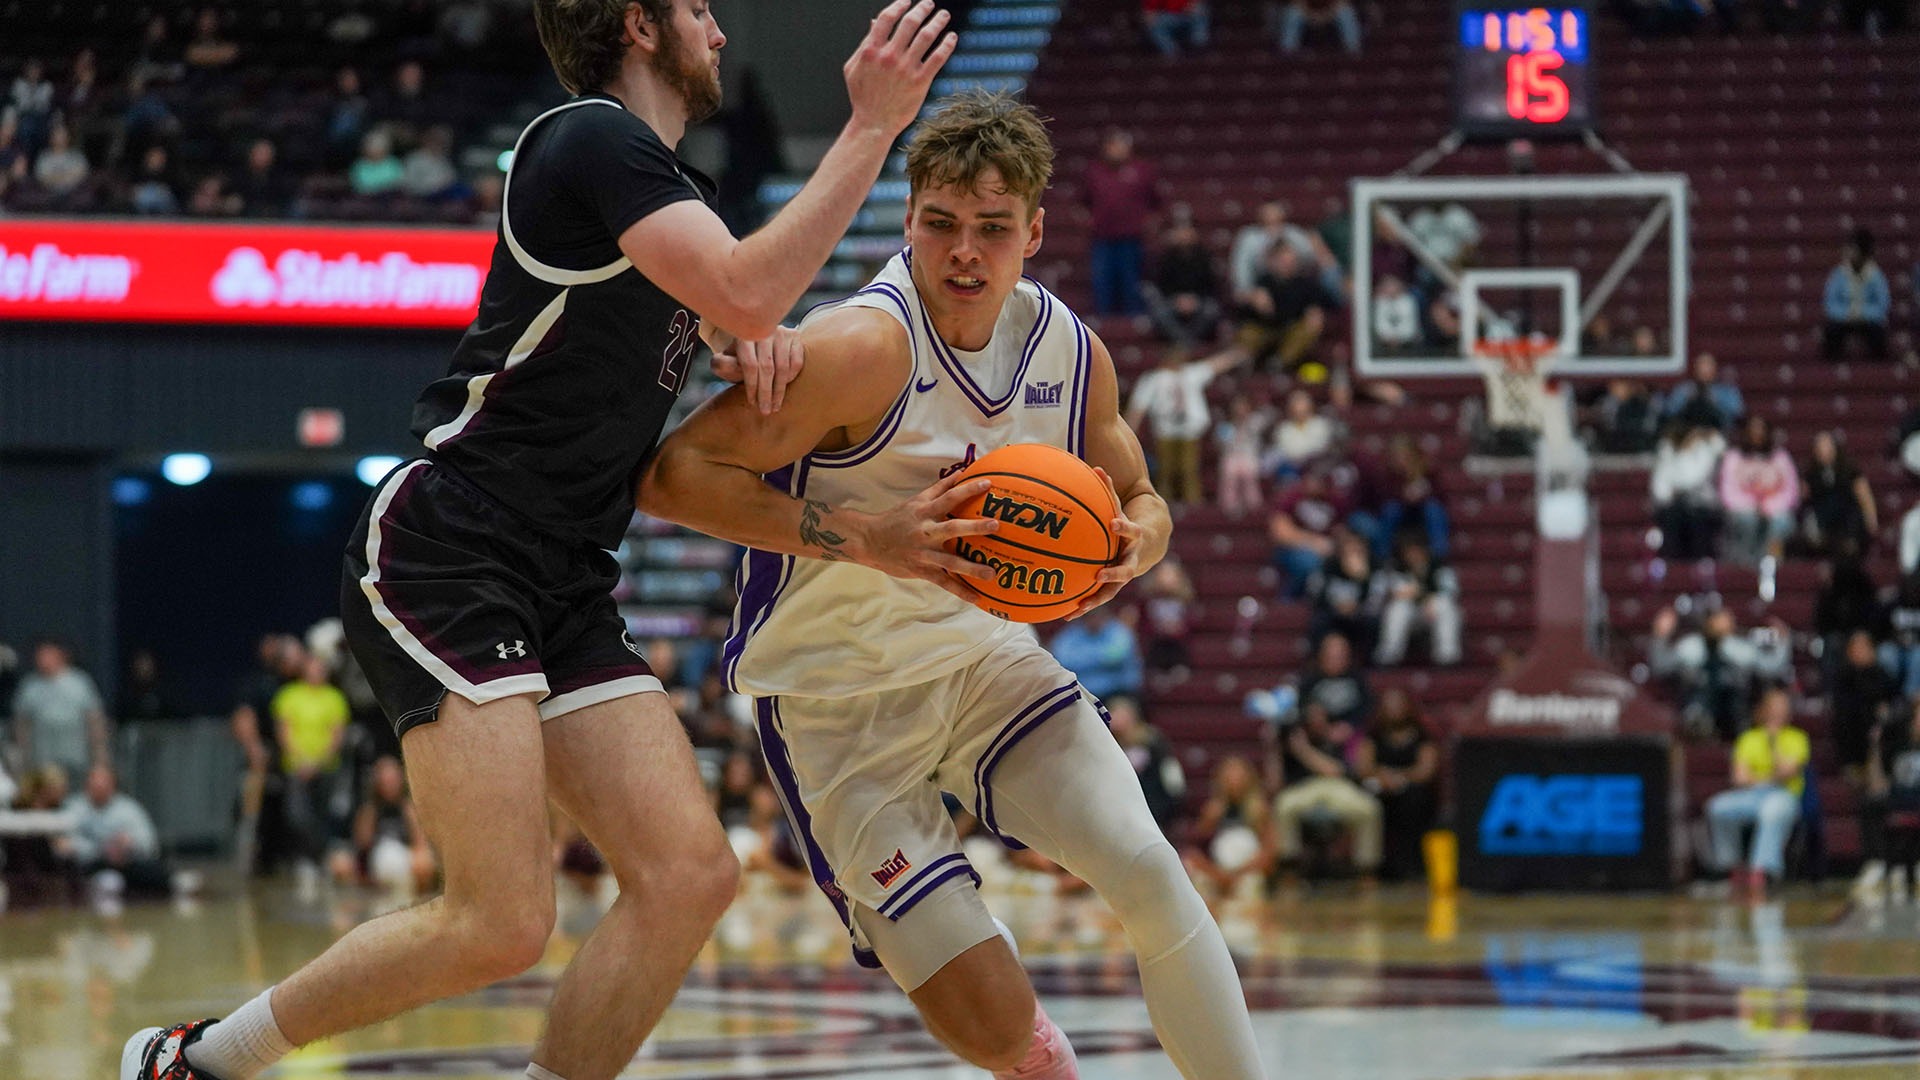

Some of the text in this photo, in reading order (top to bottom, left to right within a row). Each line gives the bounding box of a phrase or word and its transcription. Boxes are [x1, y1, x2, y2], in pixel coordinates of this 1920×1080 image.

[1506, 50, 1569, 123] 15
[1024, 380, 1065, 405] VALLEY
[981, 493, 1070, 539] NCAA
[1479, 774, 1643, 854] AGE
[870, 848, 910, 887] VALLEY
[880, 858, 892, 869] THE
